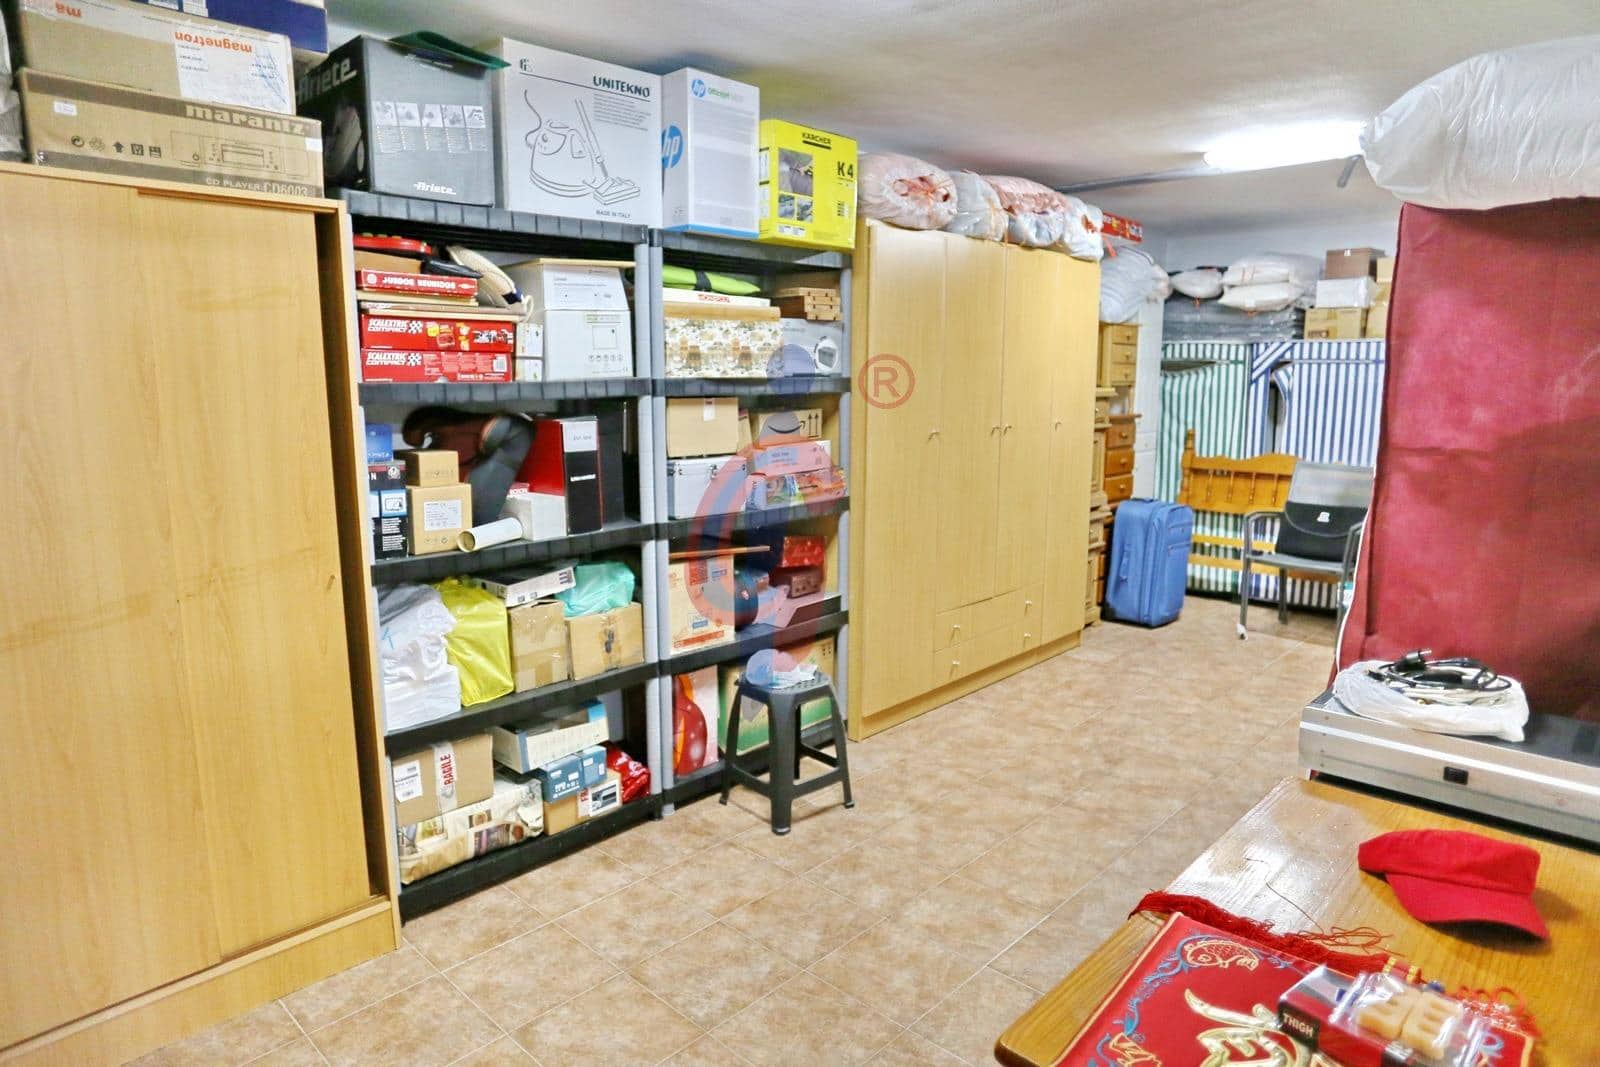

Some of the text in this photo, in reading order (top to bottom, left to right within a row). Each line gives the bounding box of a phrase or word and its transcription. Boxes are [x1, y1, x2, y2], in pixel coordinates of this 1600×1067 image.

[174, 31, 253, 53] magnetron
[593, 75, 650, 98] UNITEKNO
[692, 79, 706, 97] hp
[186, 104, 305, 136] marantz
[661, 124, 684, 169] hp
[837, 160, 854, 179] K 4
[206, 177, 220, 185] CD
[223, 179, 262, 191] PLAYER
[1282, 1012, 1313, 1037] THIGH
